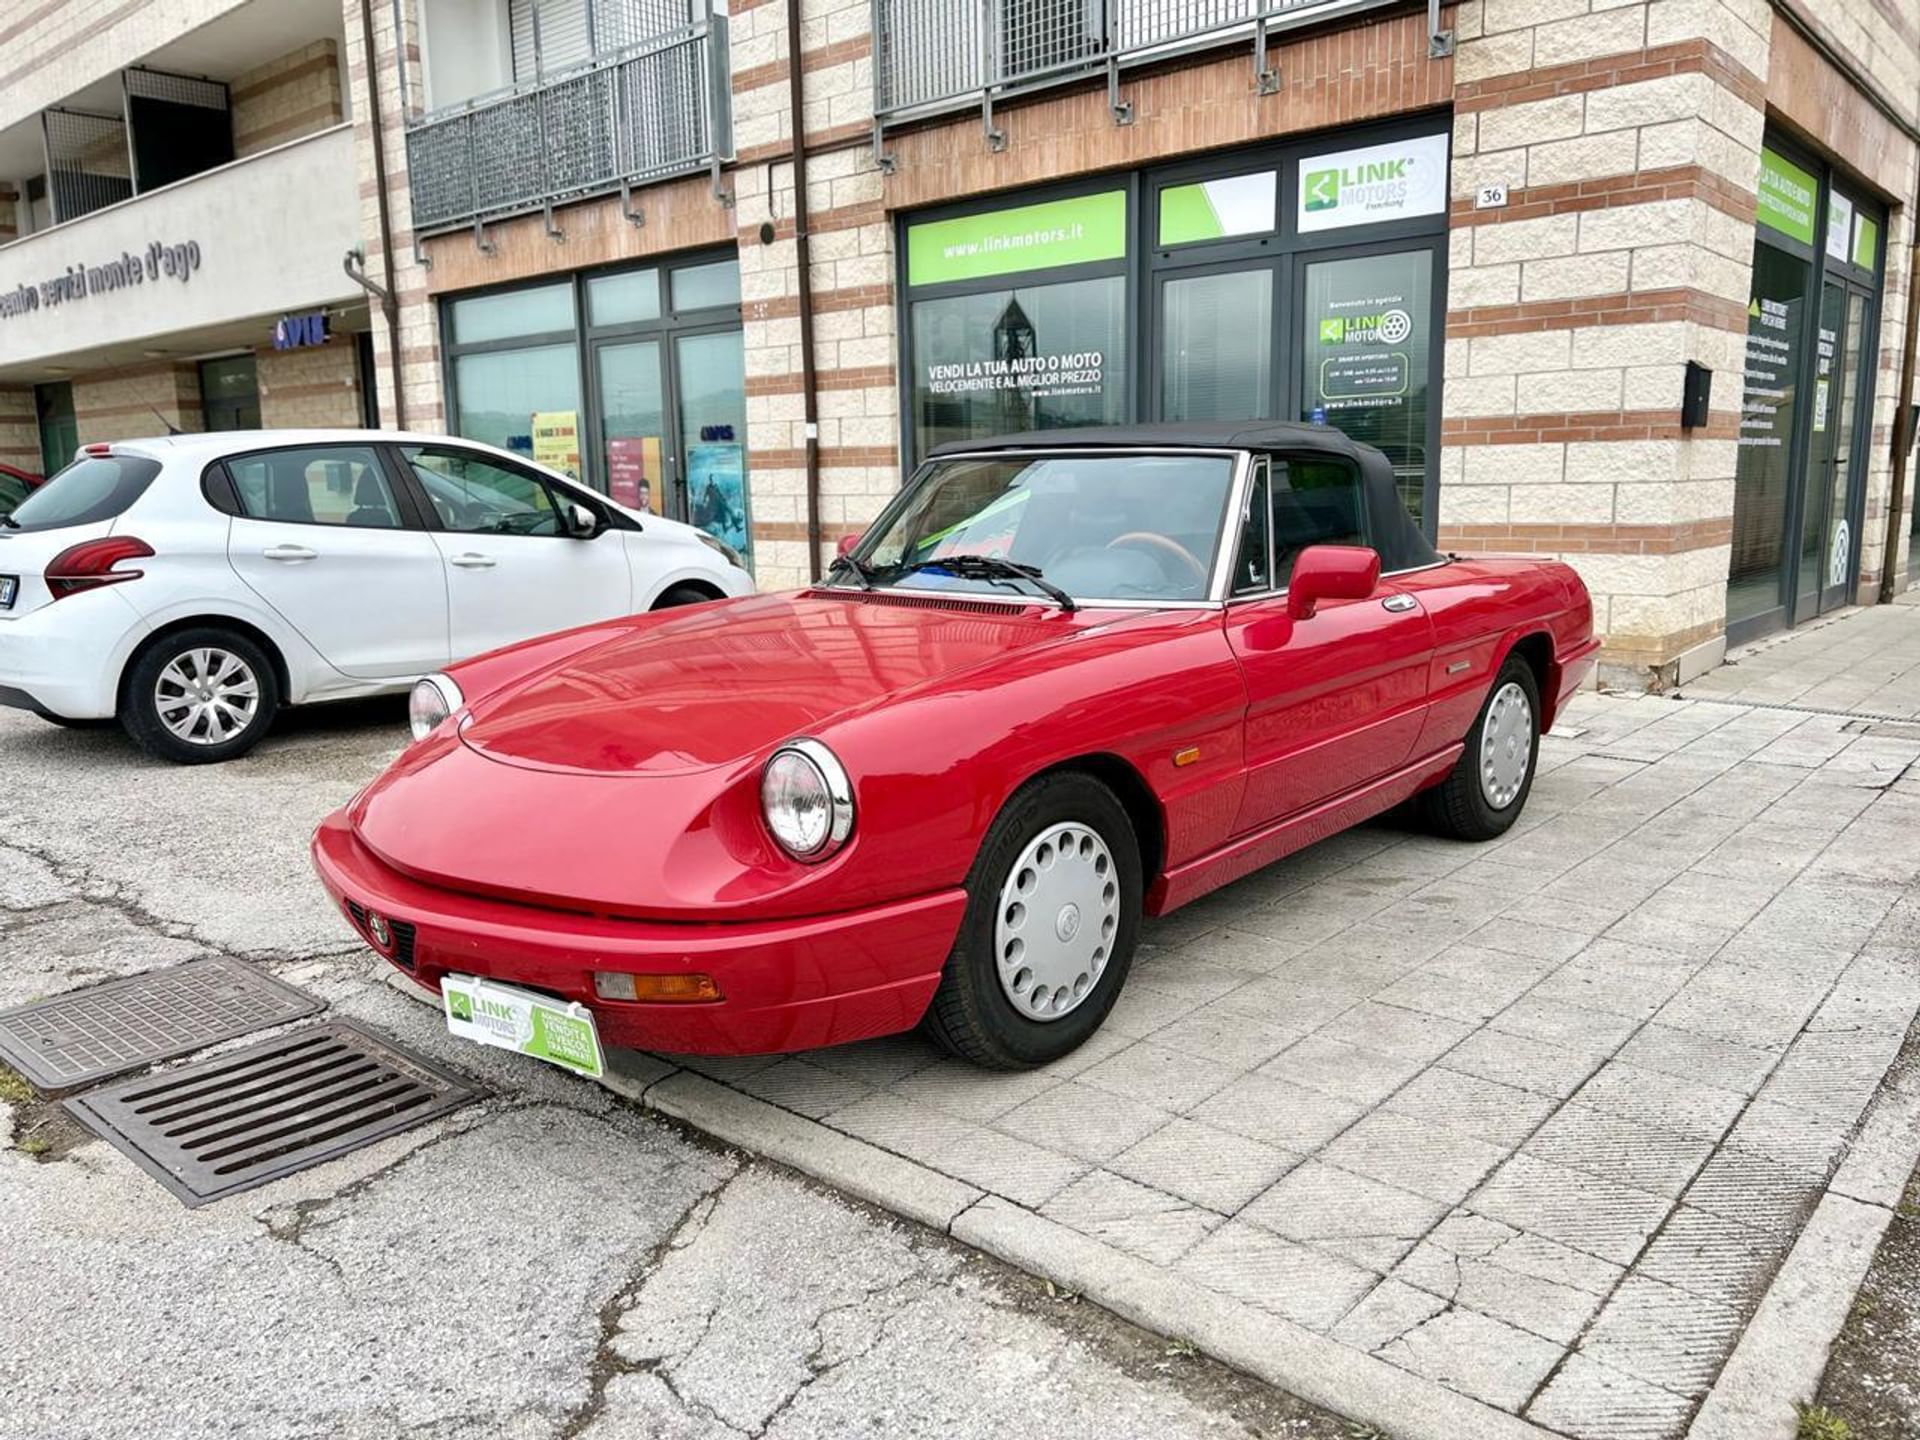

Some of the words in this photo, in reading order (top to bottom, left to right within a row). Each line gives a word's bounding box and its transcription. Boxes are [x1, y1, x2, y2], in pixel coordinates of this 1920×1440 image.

[1340, 180, 1407, 206] MOTORS
[1483, 188, 1502, 204] 36
[943, 223, 1083, 258] www.linkmotors.it
[40, 262, 87, 308] servizi
[87, 251, 143, 296] monte
[144, 240, 200, 283] d'ago
[928, 363, 964, 380] VENDI
[966, 362, 982, 377] LA
[983, 360, 1009, 376] TUA
[1010, 356, 1046, 374] AUTO
[1048, 355, 1059, 371] O
[1061, 352, 1102, 370] MOTO
[929, 376, 995, 394] VELOCEMENTE
[996, 376, 1002, 389] E
[1003, 375, 1017, 389] AL
[1017, 371, 1059, 387] MIGLIOR
[1061, 368, 1102, 384] PREZZO
[1031, 385, 1102, 398] www.linkmotors.it
[1324, 397, 1402, 410] www.linkmotors.it
[472, 996, 513, 1021] LINK
